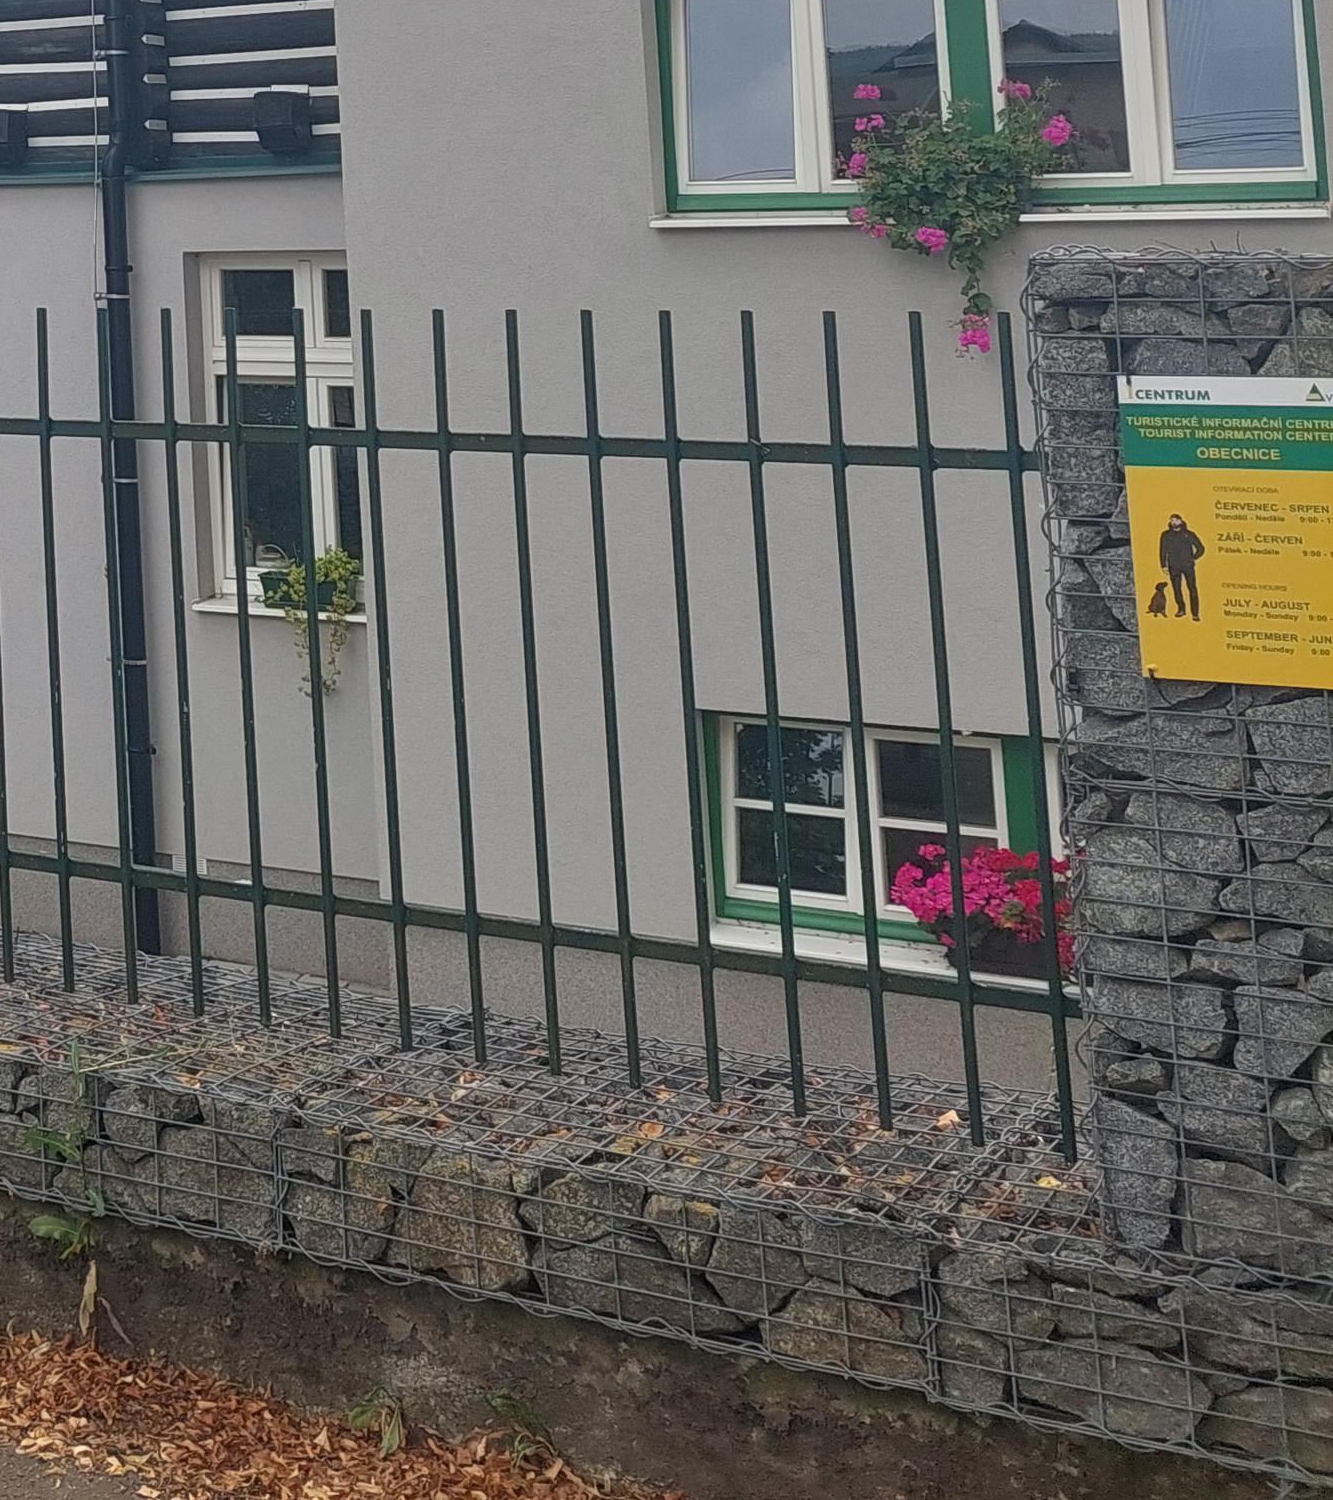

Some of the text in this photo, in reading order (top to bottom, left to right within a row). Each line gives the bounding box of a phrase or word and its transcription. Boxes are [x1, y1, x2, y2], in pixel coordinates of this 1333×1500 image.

[1126, 416, 1199, 428] TURISTICKÉ
[1202, 416, 1283, 429] INFORMAČNÍ
[1140, 428, 1193, 439] TOURIST
[1195, 429, 1283, 441] INFORMATION
[1196, 447, 1281, 461] OBECNICE
[1215, 500, 1278, 512] ČERVENEC
[1289, 504, 1330, 514] SRPEN
[1216, 532, 1244, 542] ZÁŘÍ
[1254, 533, 1303, 545] ČERVEN
[1221, 582, 1257, 590] OPENING
[1223, 599, 1251, 608] JULY
[1261, 600, 1311, 610] AUGUST
[1223, 610, 1258, 619] Monday
[1265, 612, 1299, 622] Sunday
[1226, 630, 1299, 643] SEPTEMBER
[1309, 635, 1333, 644] JUN
[1226, 643, 1254, 652] Friday
[1262, 645, 1295, 655] Sunday
